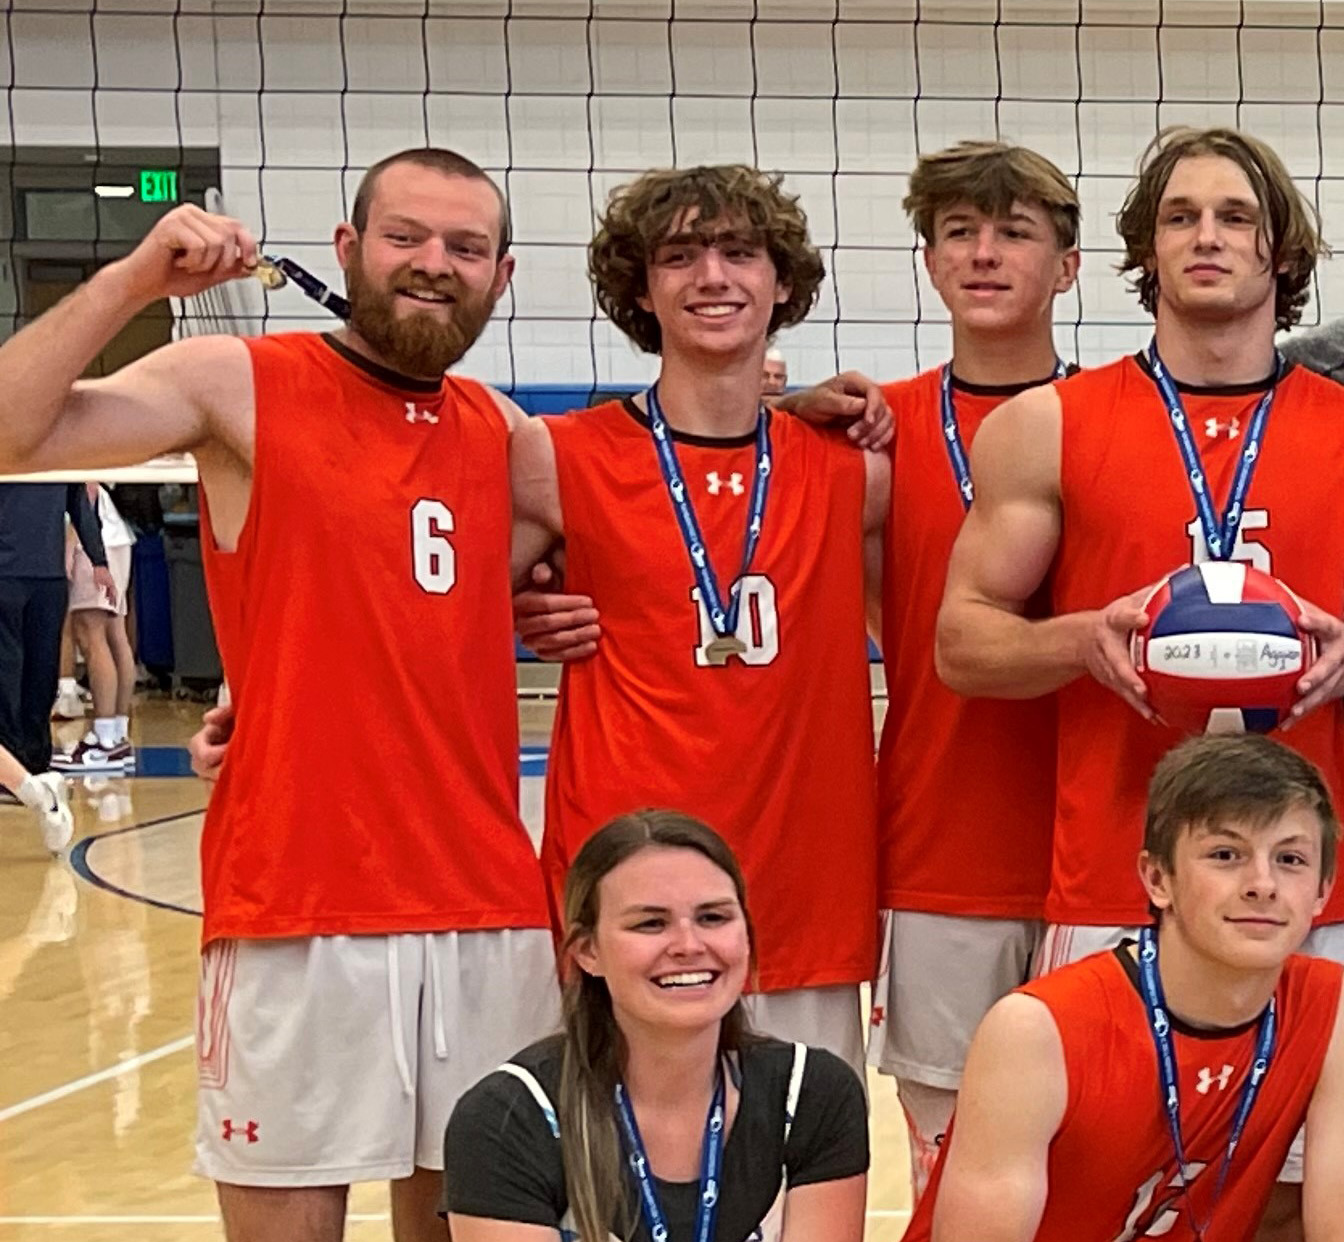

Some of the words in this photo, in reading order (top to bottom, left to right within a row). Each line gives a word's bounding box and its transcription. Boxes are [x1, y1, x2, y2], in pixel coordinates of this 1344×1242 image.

[142, 171, 177, 202] EXIT
[410, 497, 457, 594] 6
[690, 573, 779, 667] 10
